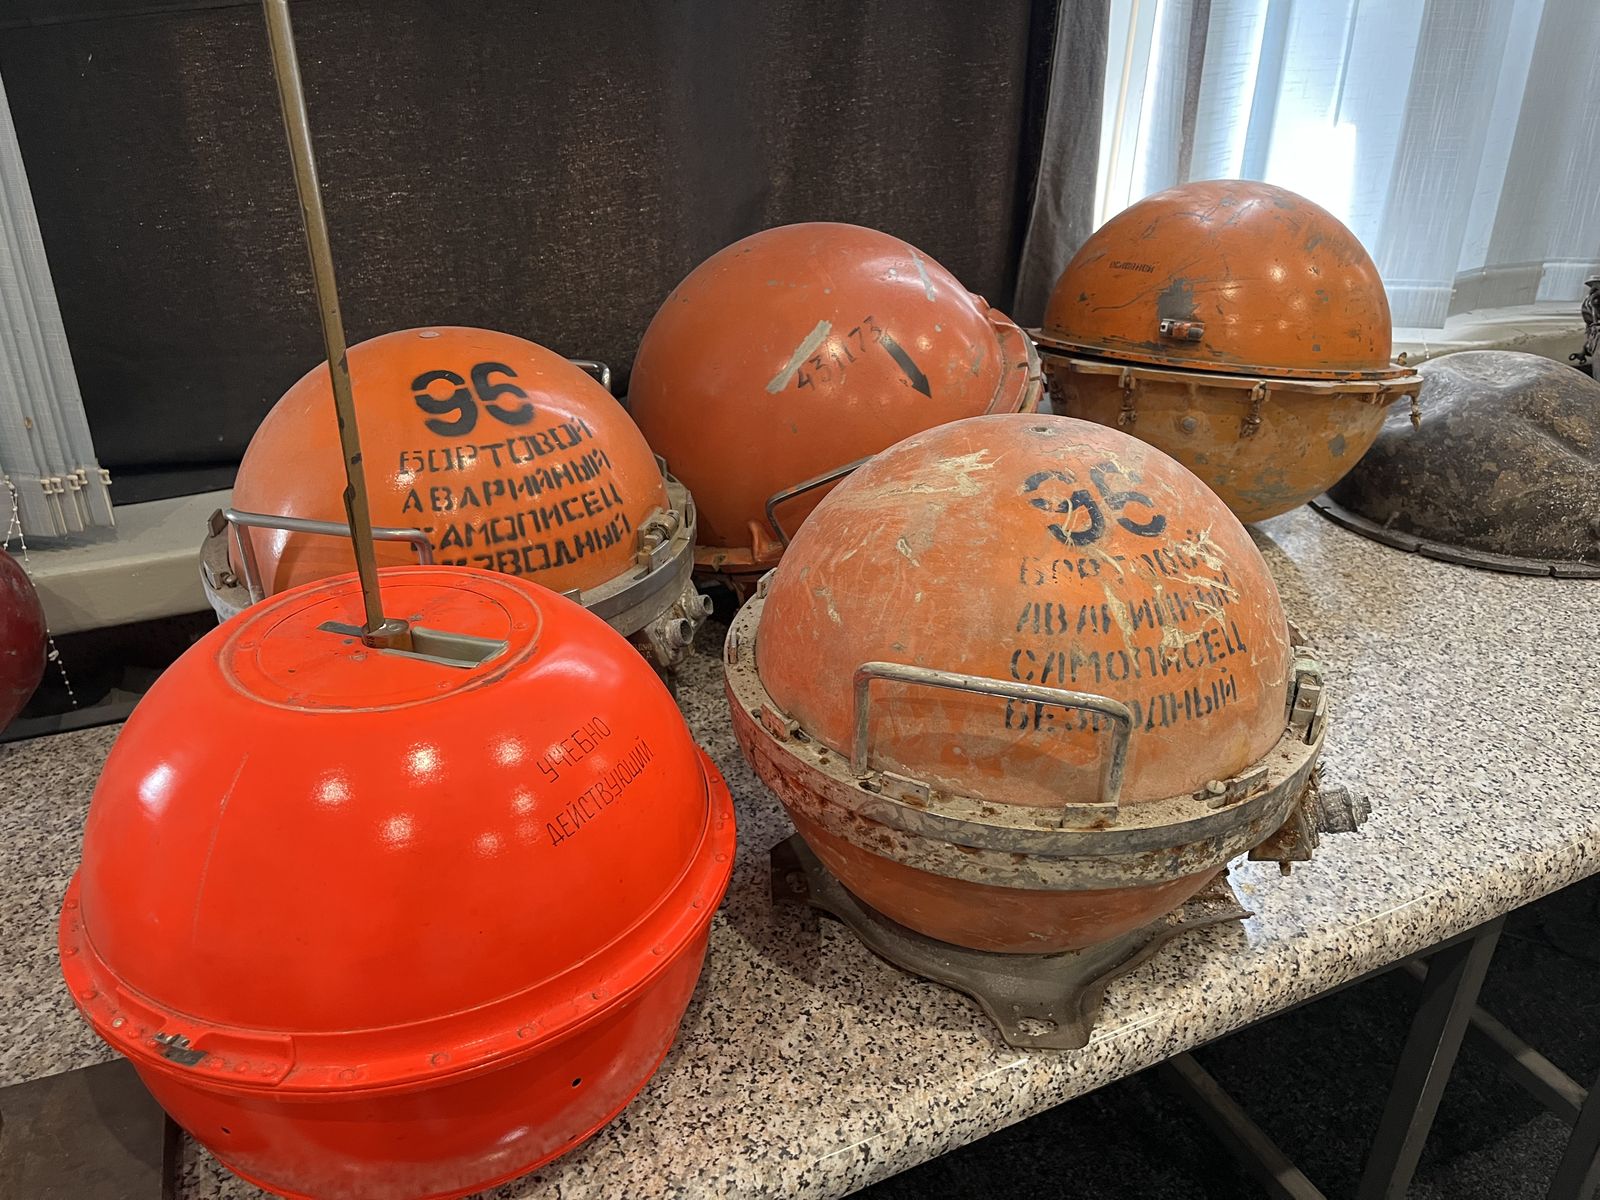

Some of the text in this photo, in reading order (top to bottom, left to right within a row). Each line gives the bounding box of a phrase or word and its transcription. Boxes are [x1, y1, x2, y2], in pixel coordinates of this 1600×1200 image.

[411, 361, 535, 437] 96
[399, 416, 593, 475] БОРТОВОЙ
[402, 448, 612, 513] АВАРИЙНЫЙ
[1020, 530, 1221, 586] БОРТОВО
[1010, 620, 1247, 684] САМОПИСЕЦ
[536, 716, 611, 783] УЧЕБНО
[546, 736, 654, 847] ДЕЙСТВУЮЩИЙ
